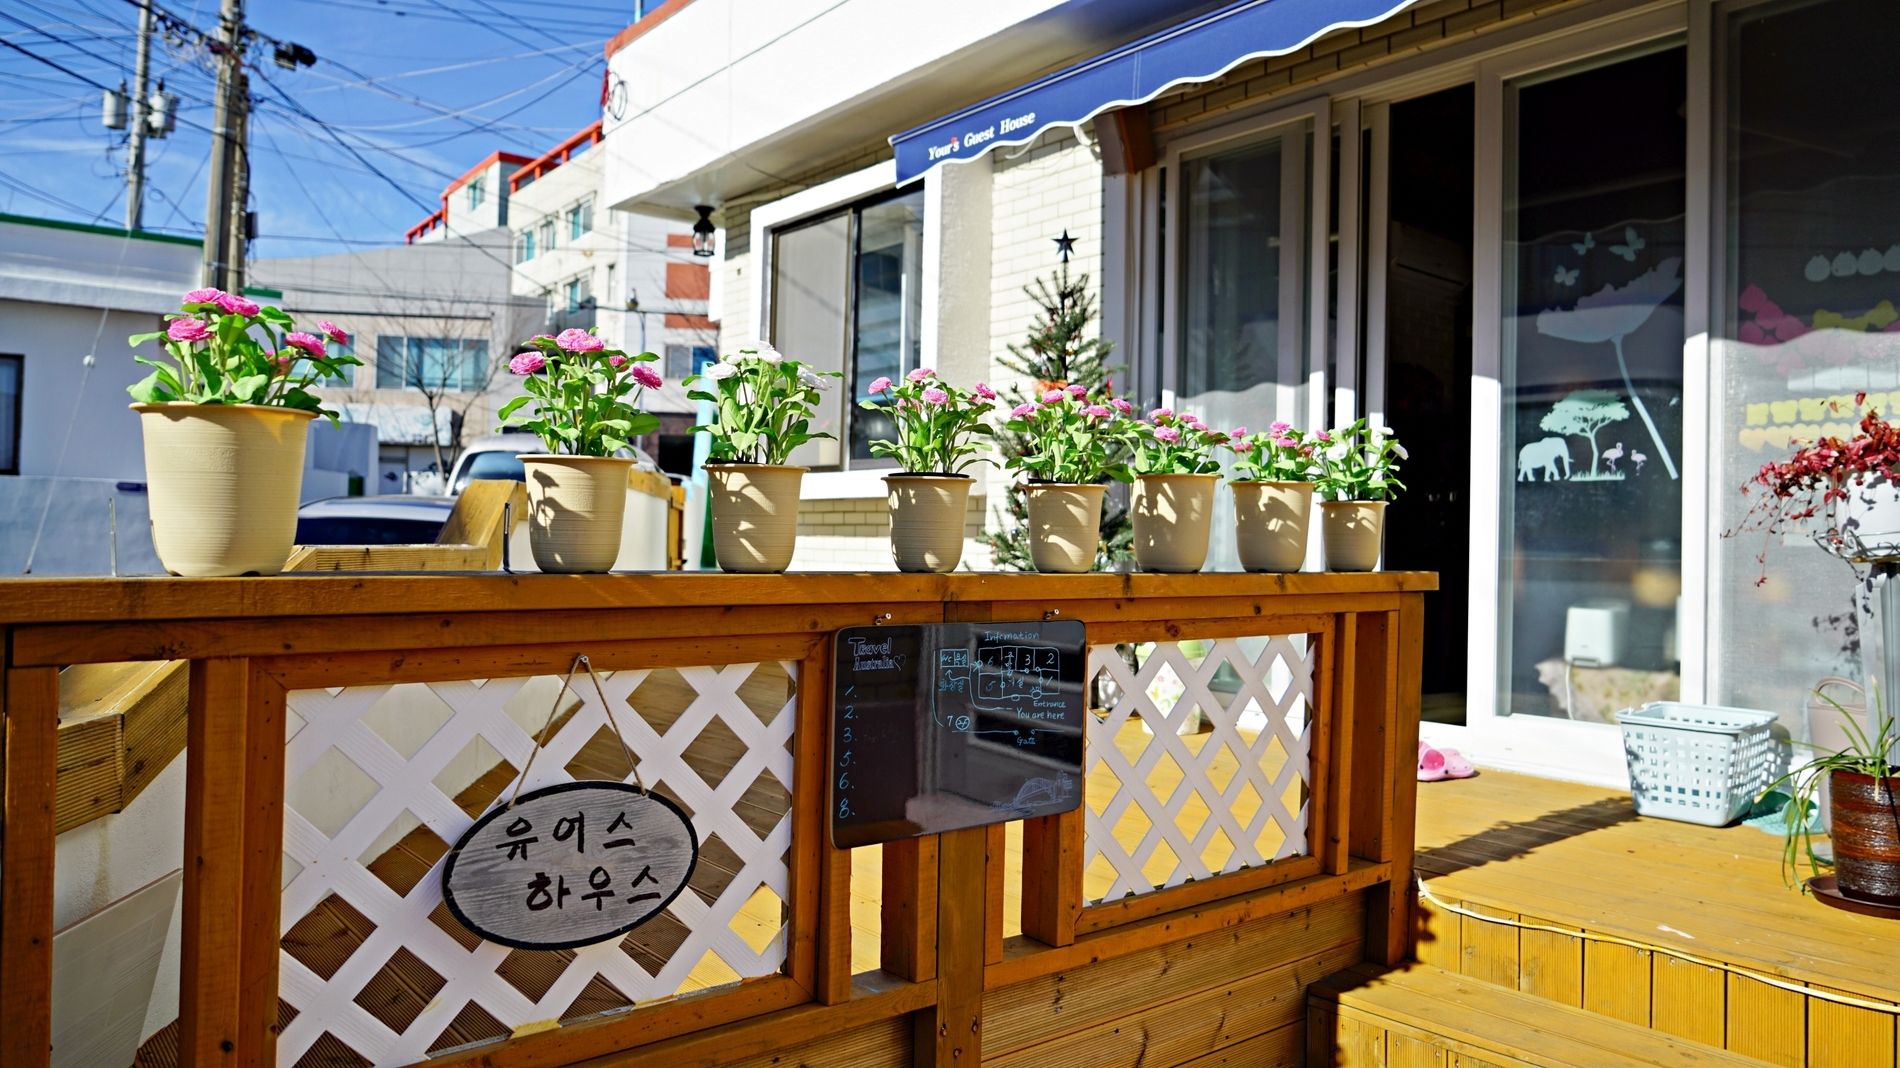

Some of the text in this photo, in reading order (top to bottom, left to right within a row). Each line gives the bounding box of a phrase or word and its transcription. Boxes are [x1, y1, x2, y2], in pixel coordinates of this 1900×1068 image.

[928, 112, 1036, 160] Your's Guest House
[848, 637, 892, 656] Travel
[1025, 654, 1031, 665] 3
[1046, 652, 1055, 664] 2
[1033, 700, 1067, 709] Entrance
[1016, 707, 1065, 720] You are here
[496, 811, 635, 861] 유어스
[526, 865, 661, 911] 하우스
